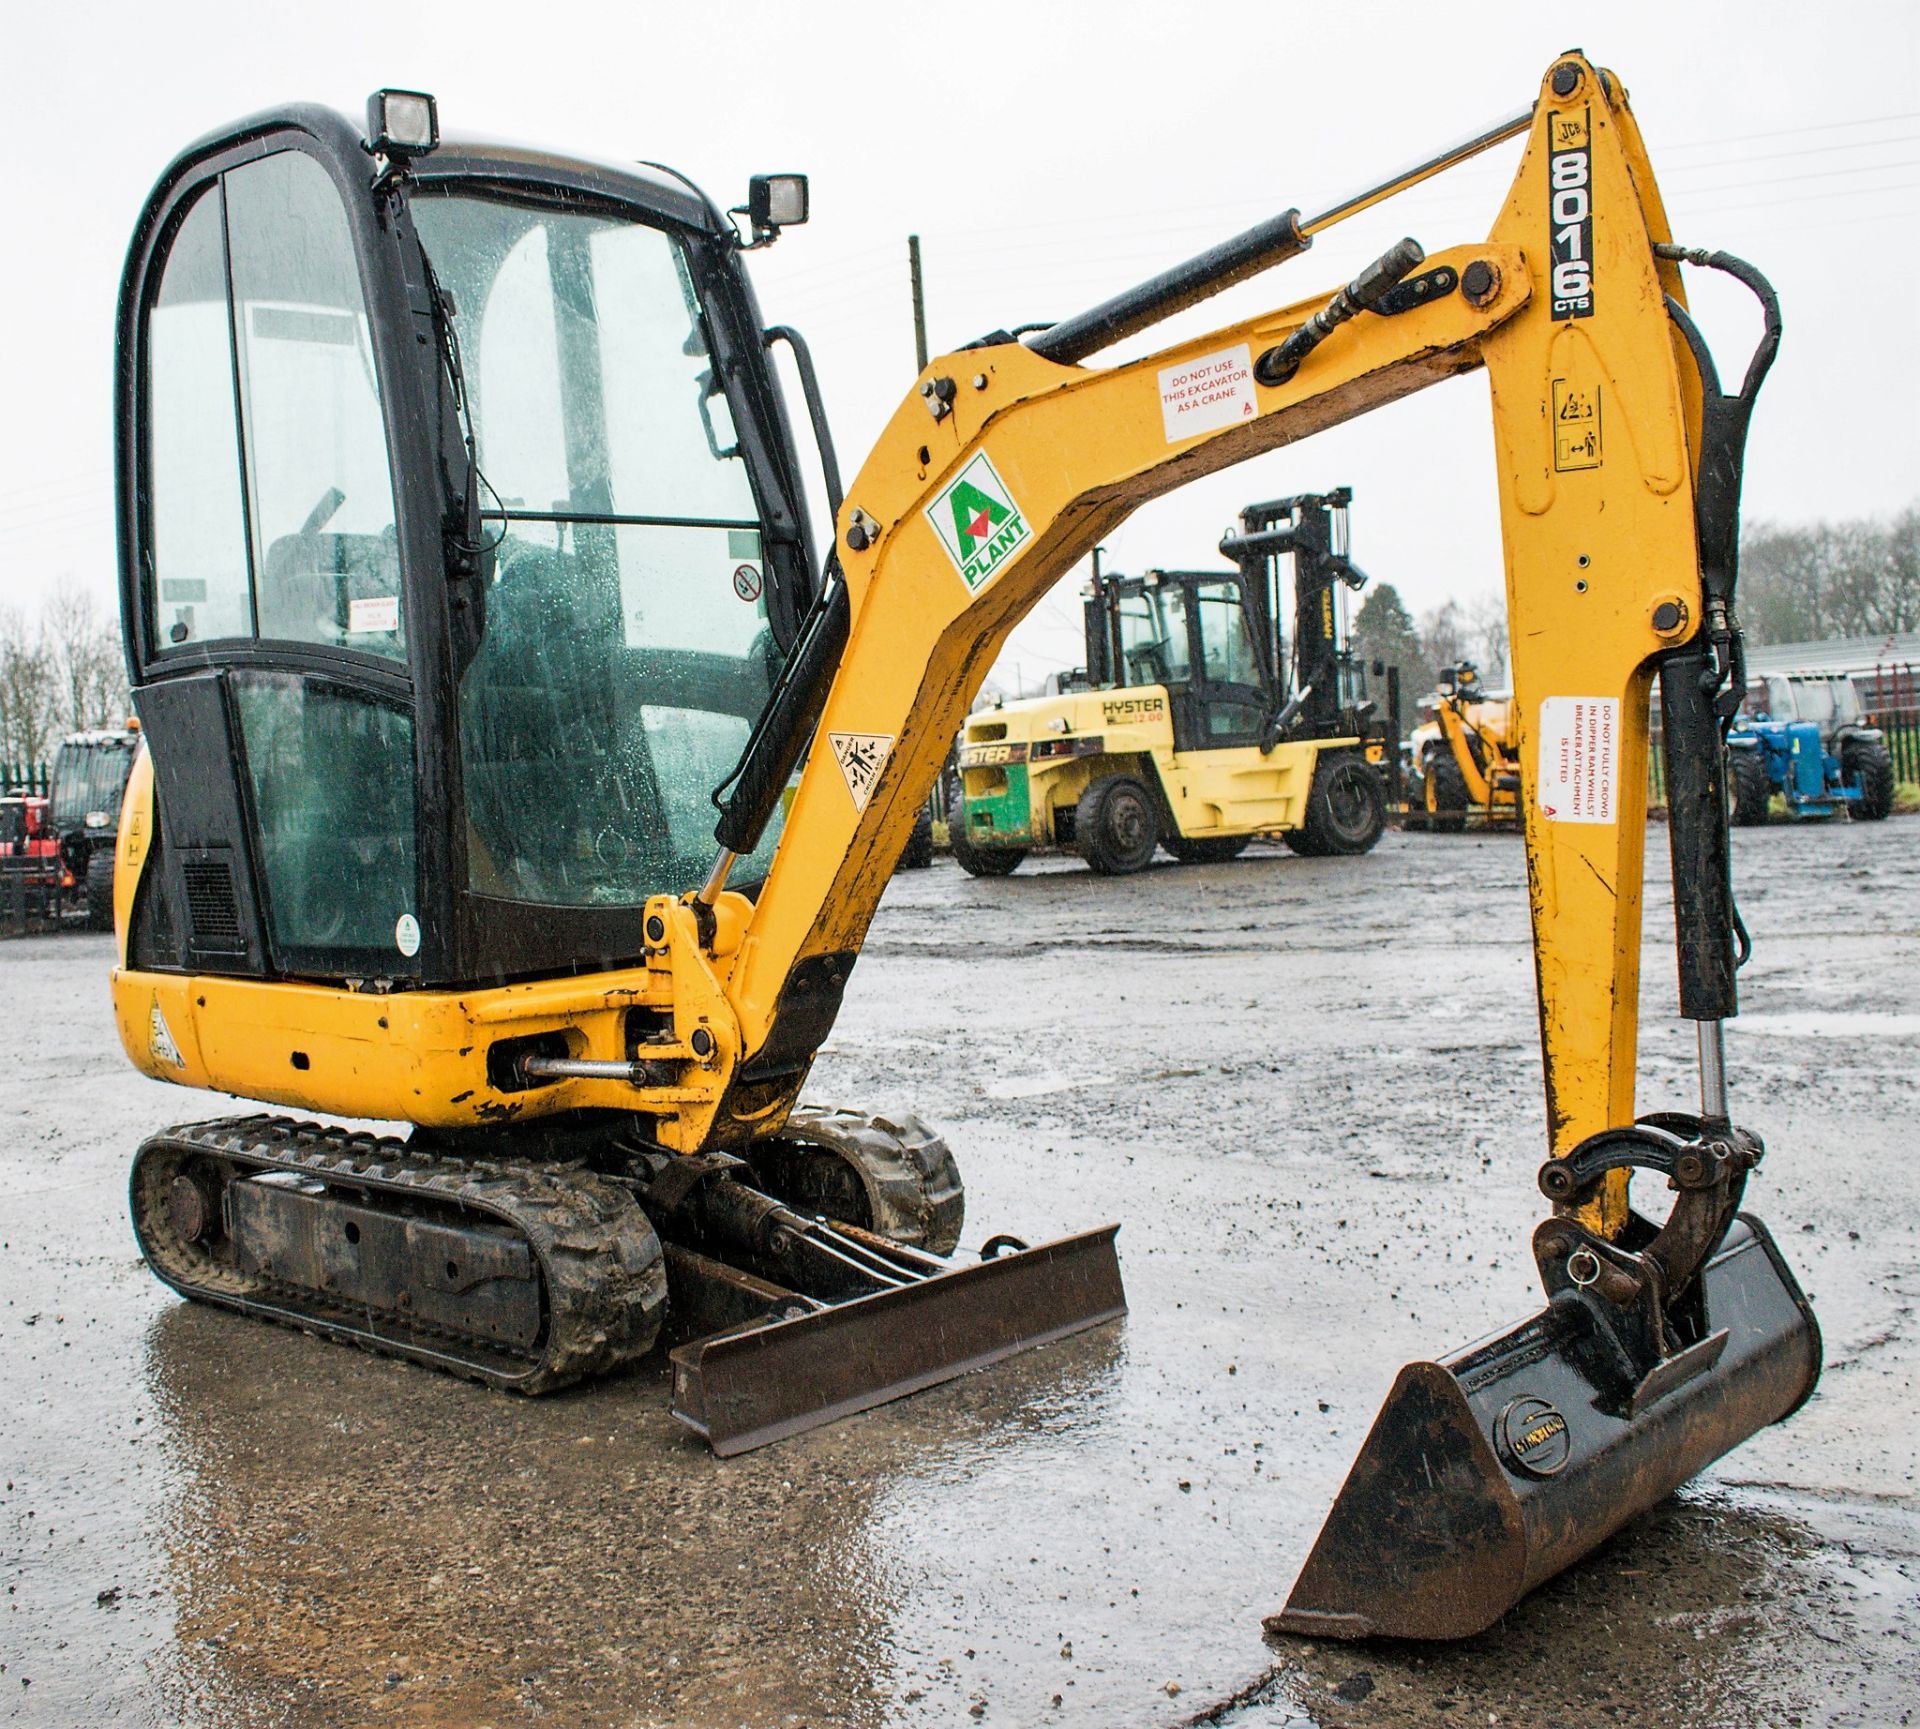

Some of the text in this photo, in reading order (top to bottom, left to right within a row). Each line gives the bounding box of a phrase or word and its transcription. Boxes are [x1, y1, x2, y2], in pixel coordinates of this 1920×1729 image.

[1562, 123, 1580, 139] JCB
[1552, 152, 1590, 298] 8016
[1554, 297, 1589, 312] CTS
[1162, 369, 1248, 403] THIS EXCAVATOR
[1172, 360, 1233, 387] DO NOT USE
[1178, 387, 1236, 413] AS A CRANE
[950, 480, 1011, 562] A
[964, 515, 1024, 586] PLANT
[1103, 698, 1163, 714] HYSTER
[1604, 705, 1611, 720] DO
[840, 737, 854, 764] DANGER
[1560, 738, 1568, 783] IS FITTED
[1573, 705, 1583, 816] BREAKER ATTACHMENT
[1587, 706, 1597, 816] IN DIPPER RAM WHILST
[1602, 748, 1610, 776] FULLY
[864, 772, 876, 795] CRUSH
[1600, 780, 1609, 818] CROWD
